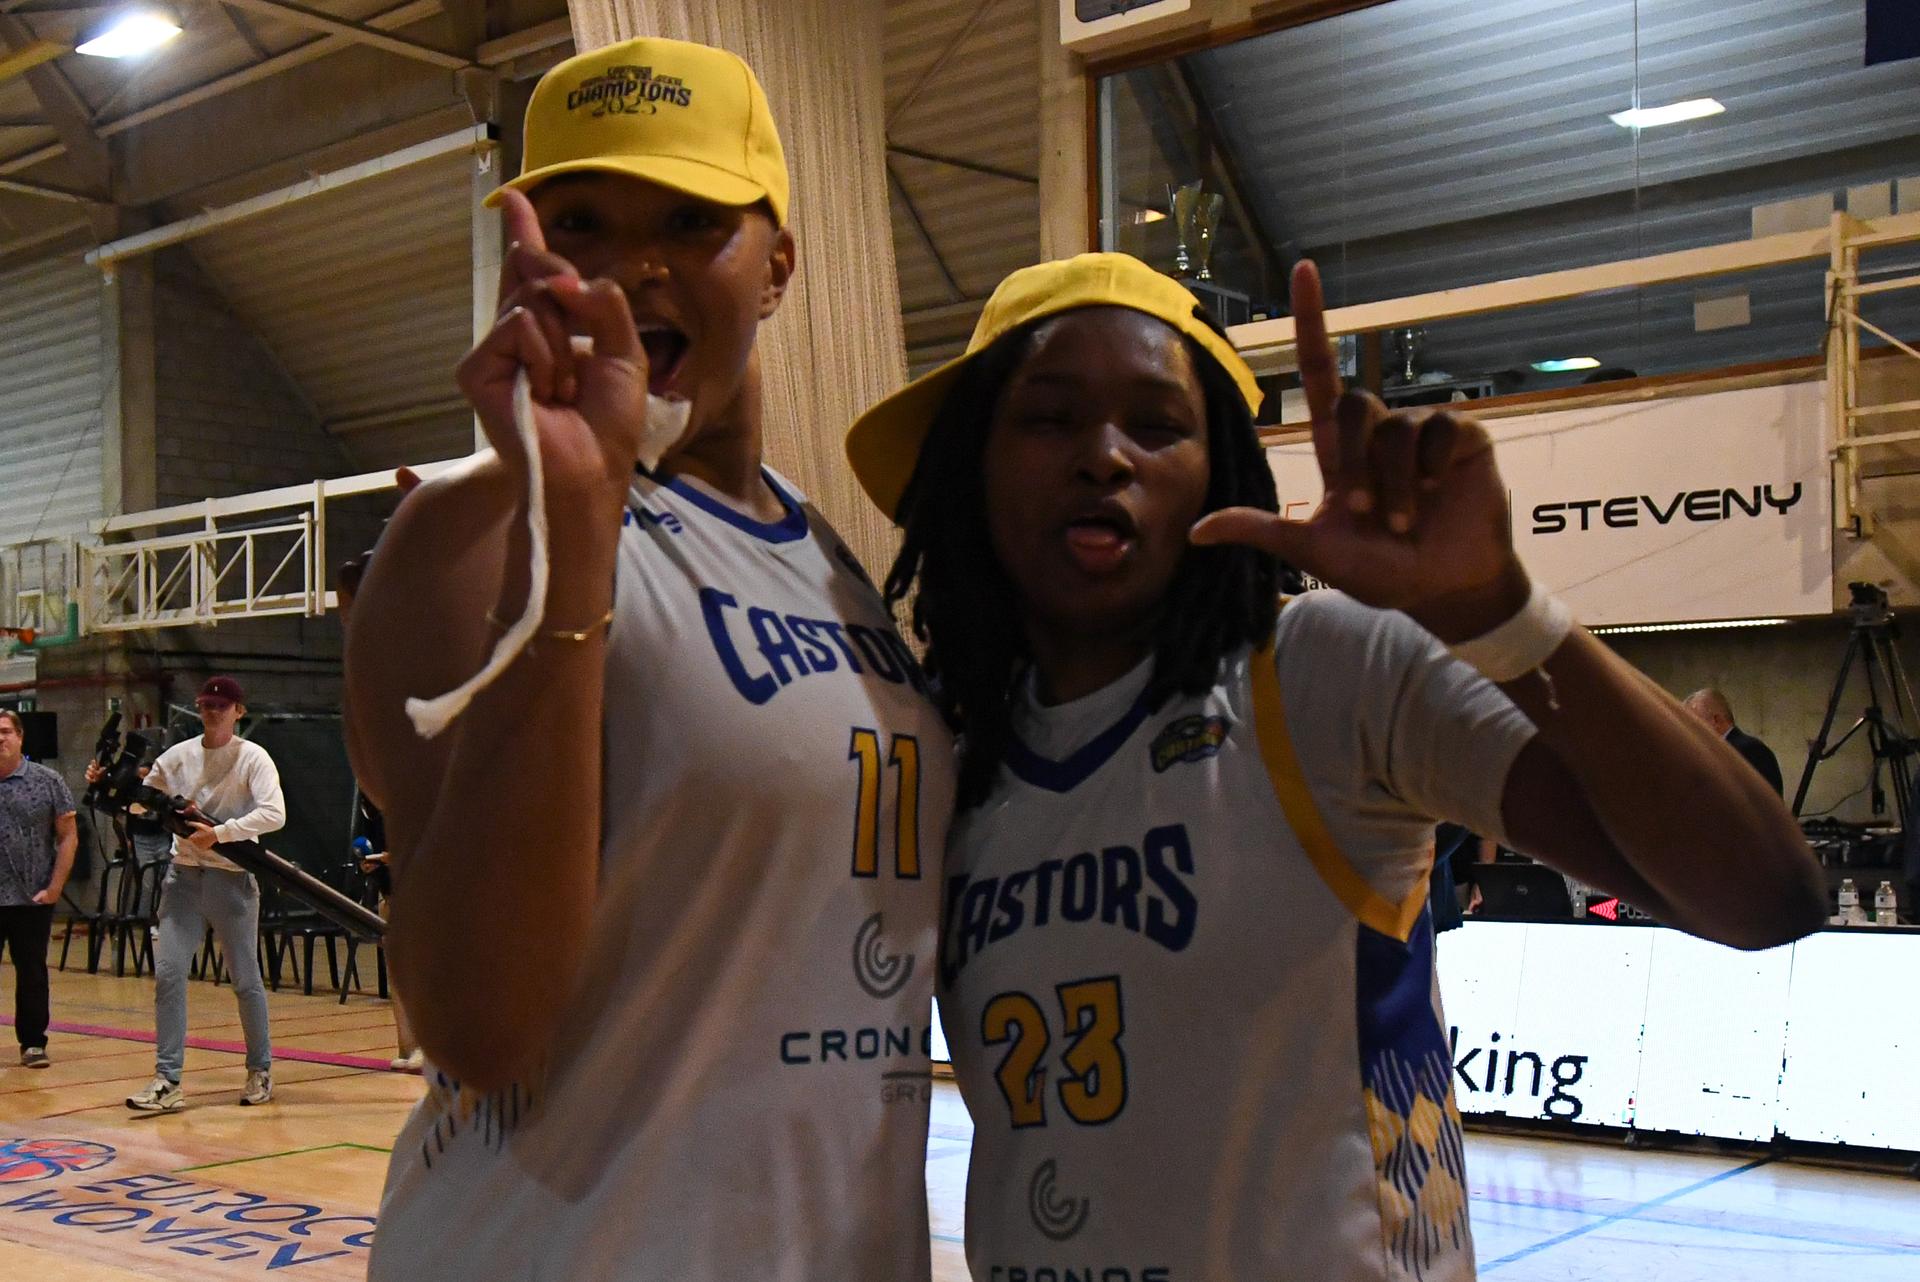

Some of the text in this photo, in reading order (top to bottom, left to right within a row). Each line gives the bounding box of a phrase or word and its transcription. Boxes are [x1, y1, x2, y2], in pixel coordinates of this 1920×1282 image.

[567, 80, 692, 110] CHAMPIONS
[1532, 481, 1802, 534] STEVENY
[849, 726, 921, 880] 11
[981, 975, 1128, 1130] 23
[1450, 1026, 1588, 1121] king
